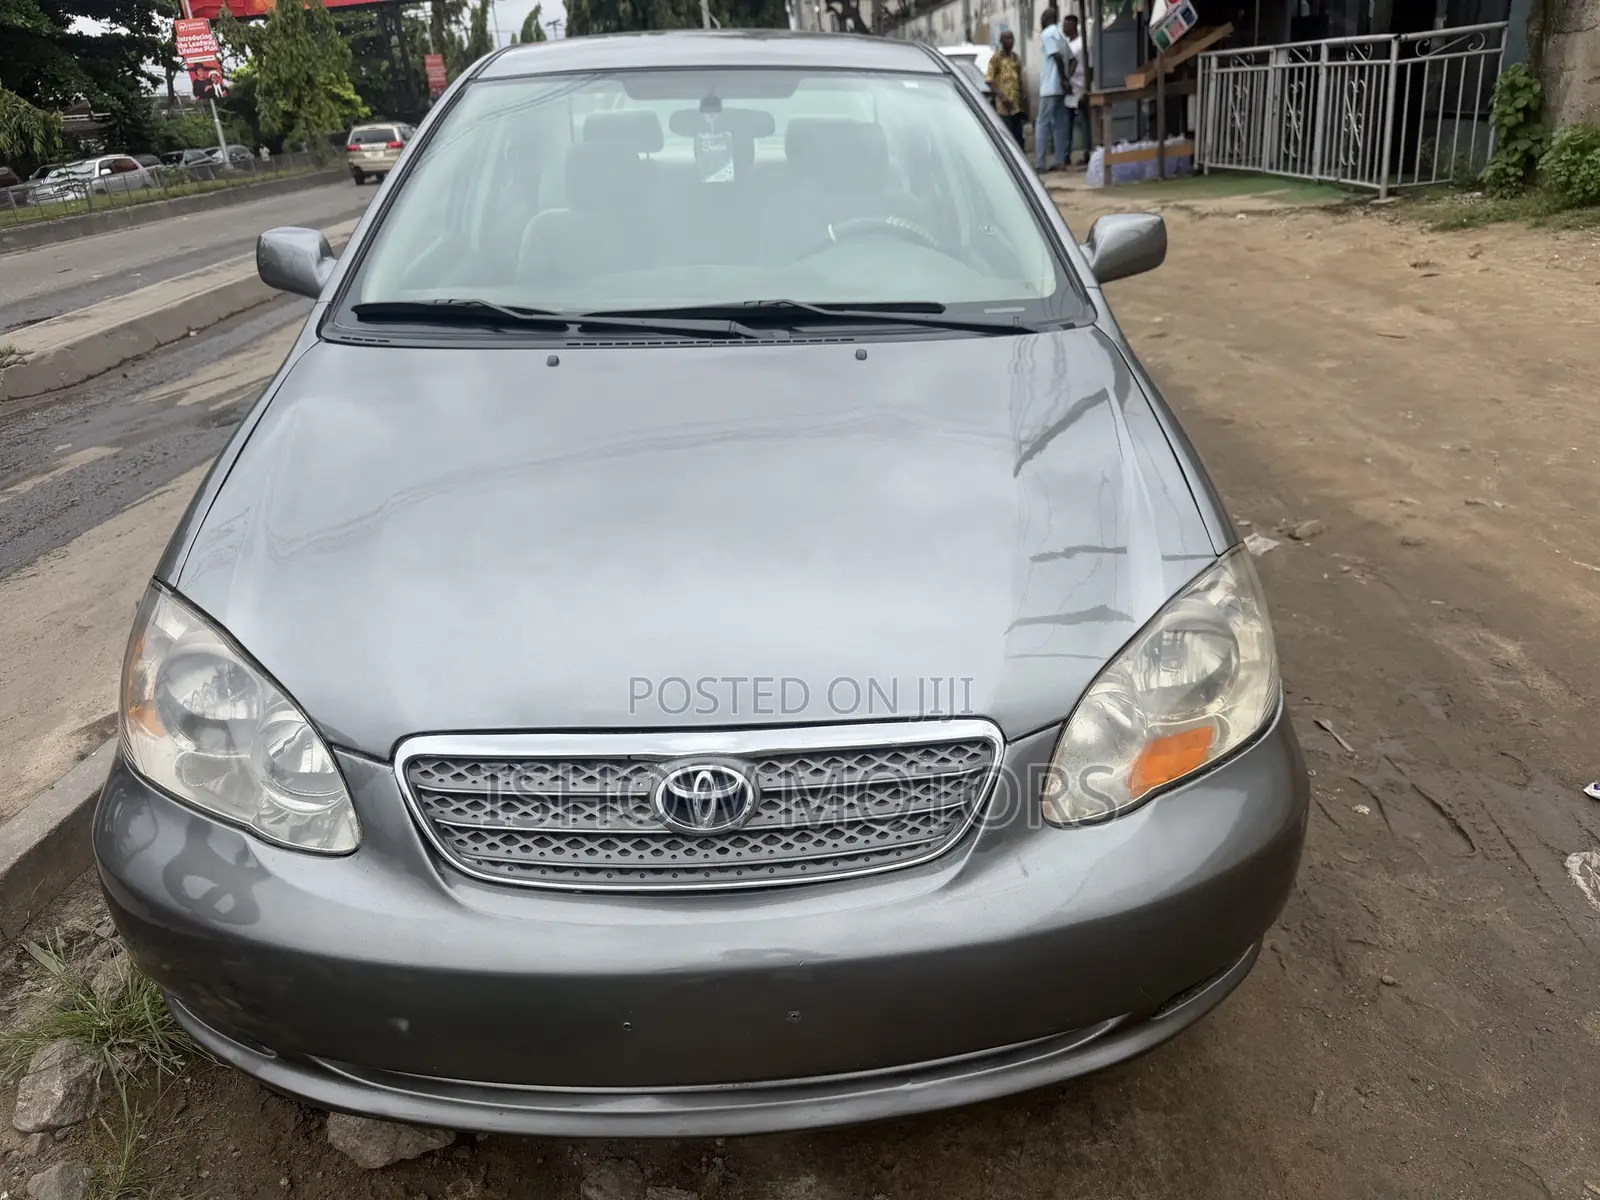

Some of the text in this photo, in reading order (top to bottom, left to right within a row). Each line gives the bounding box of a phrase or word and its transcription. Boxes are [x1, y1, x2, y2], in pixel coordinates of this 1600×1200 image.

[177, 33, 213, 42] Introducing
[188, 40, 216, 48] Leadway
[178, 46, 204, 55] Lifetime
